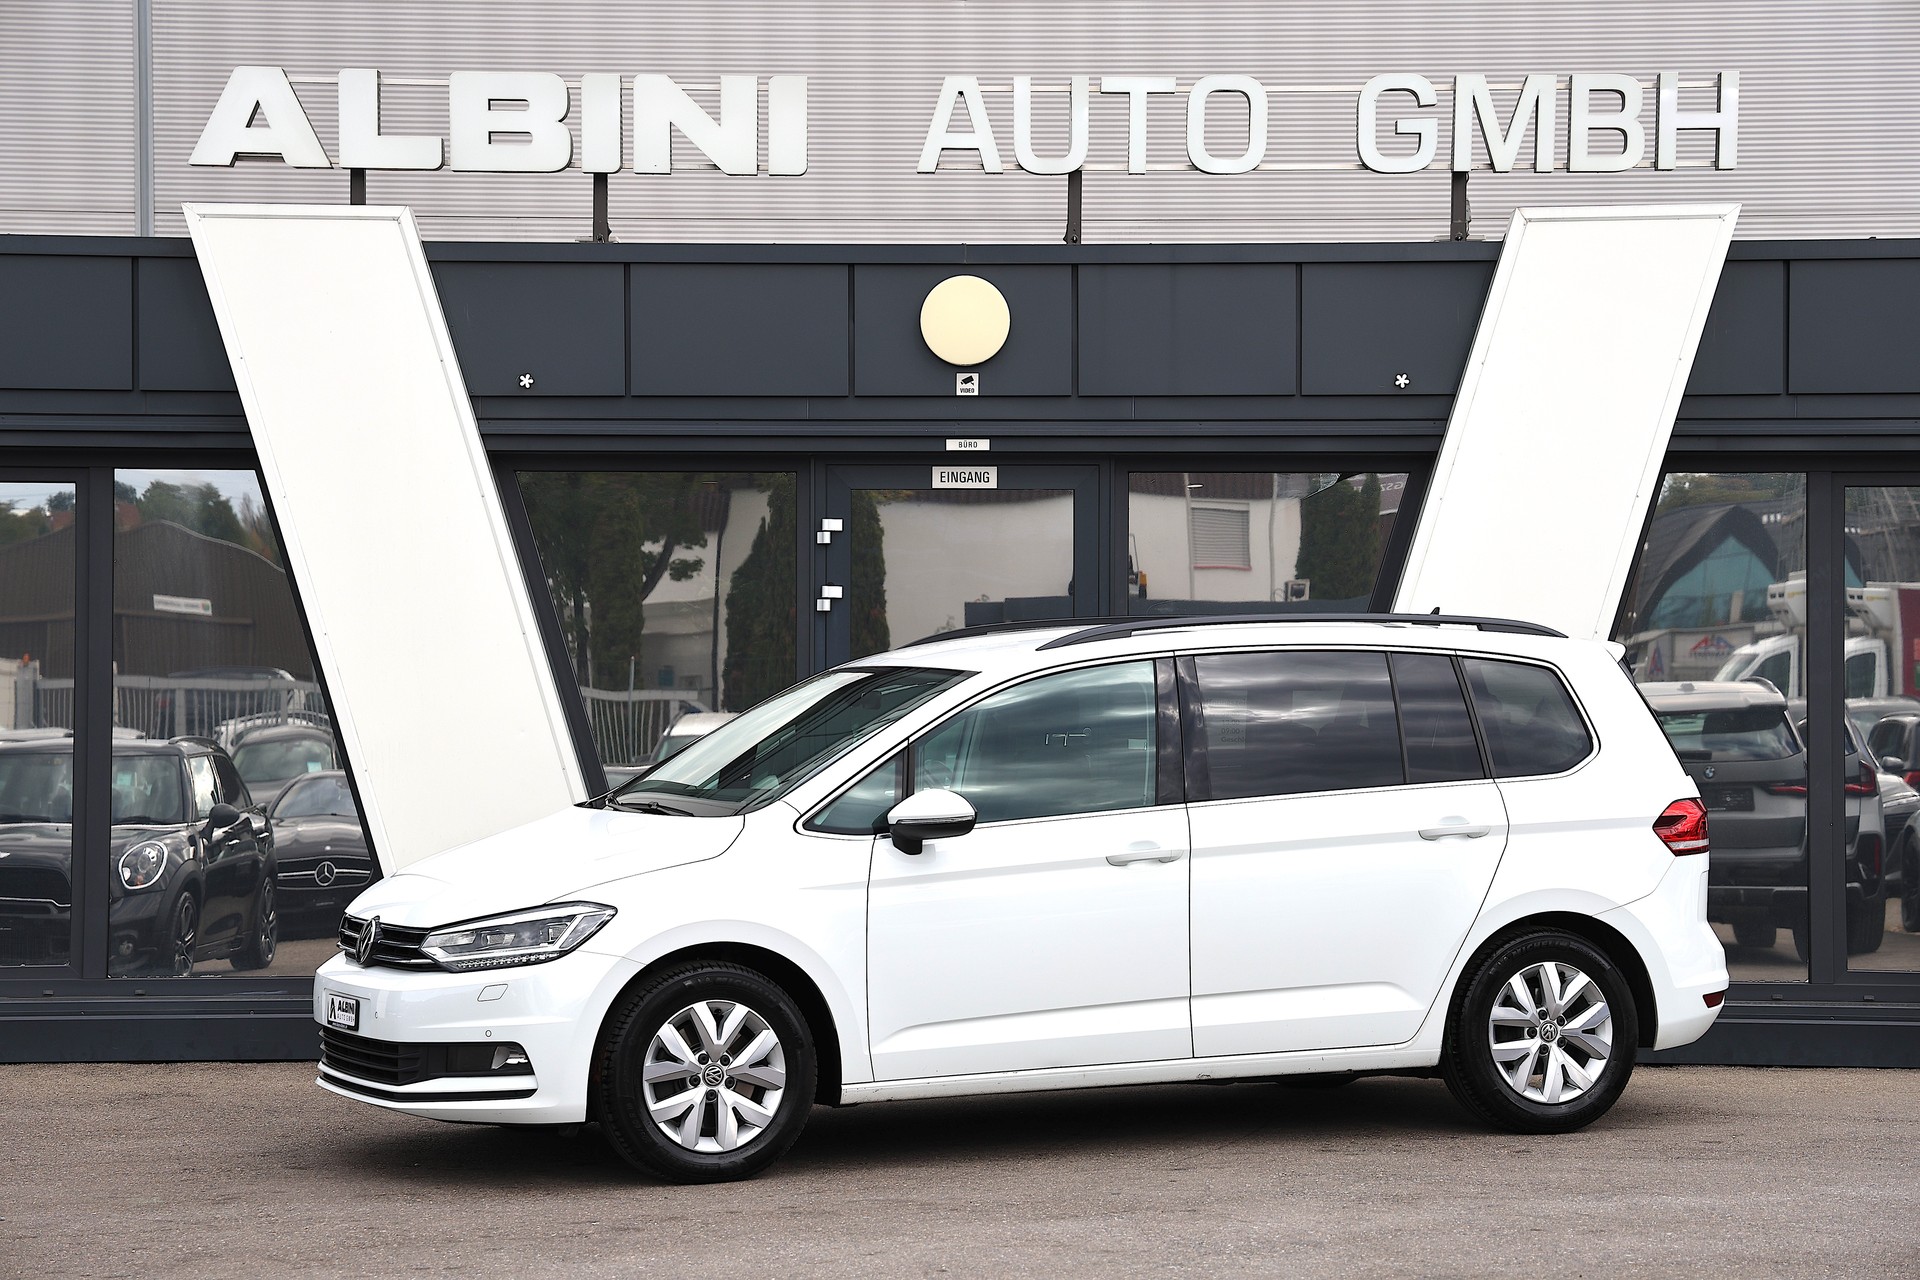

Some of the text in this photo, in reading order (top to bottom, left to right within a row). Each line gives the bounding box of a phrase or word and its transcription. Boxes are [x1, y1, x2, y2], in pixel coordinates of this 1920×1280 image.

[187, 65, 1740, 177] ALBINI AUTO GMBH
[958, 439, 978, 449] BÜRO
[940, 471, 990, 484] EINGANG
